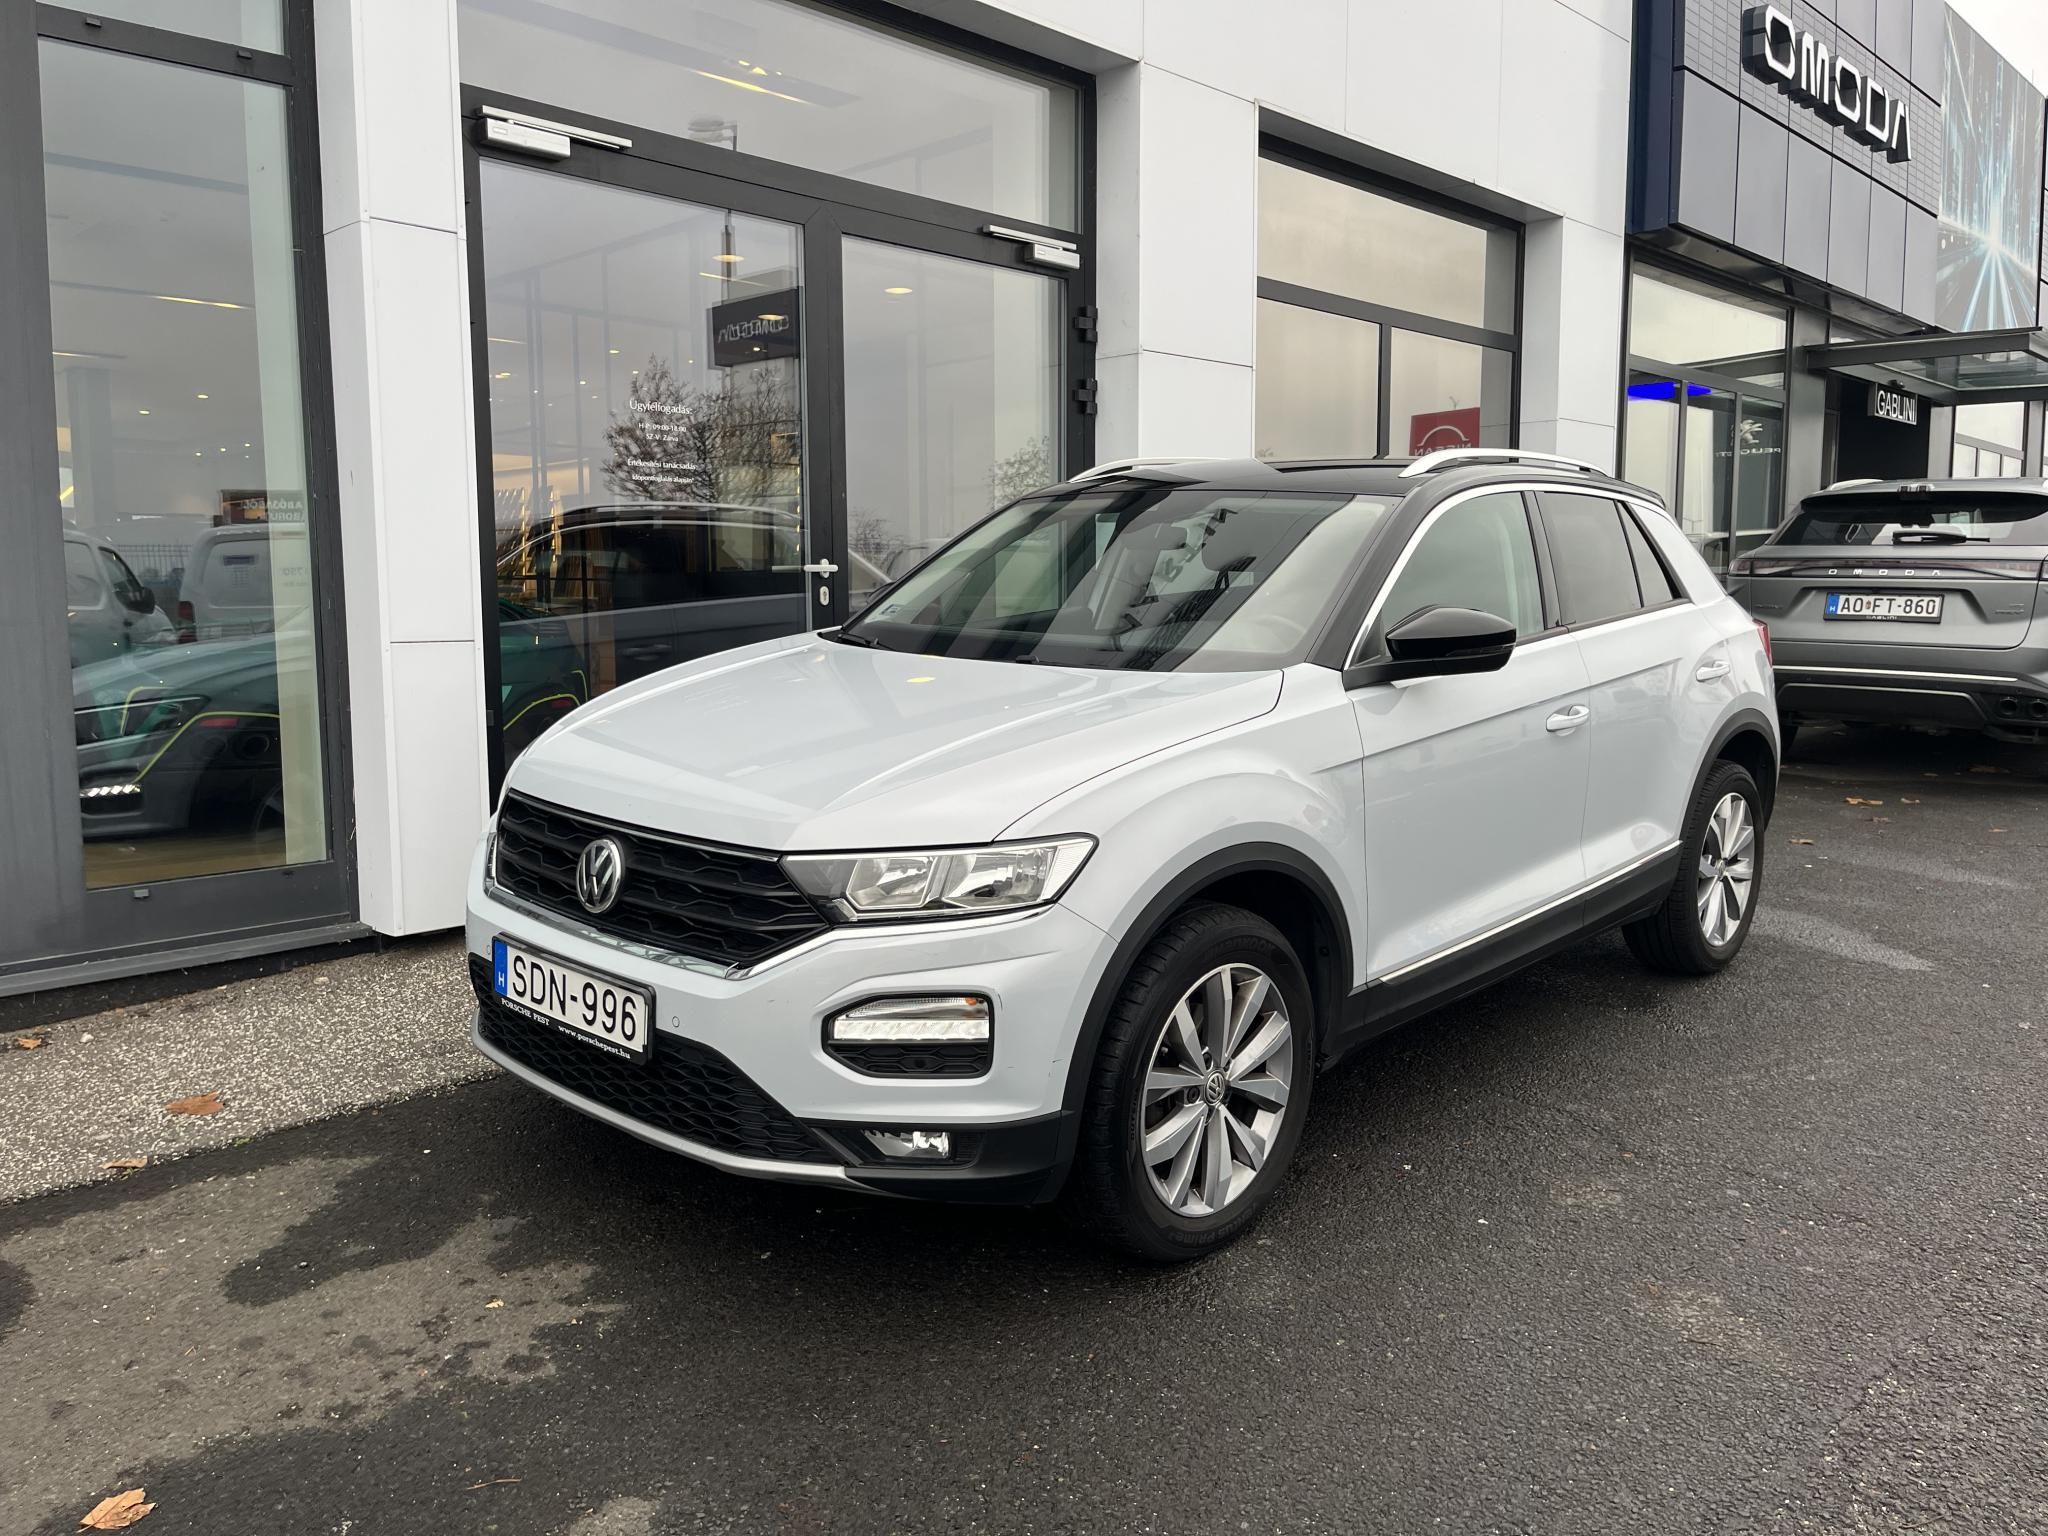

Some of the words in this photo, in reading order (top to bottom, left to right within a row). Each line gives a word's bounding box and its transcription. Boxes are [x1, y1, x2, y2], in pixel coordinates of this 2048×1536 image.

[1765, 5, 1912, 161] OMODA
[1877, 390, 1916, 423] GABLINI
[1828, 568, 1941, 577] OMODA
[498, 971, 505, 988] H
[512, 955, 637, 1042] SDN-996
[501, 997, 532, 1020] PORSCHE
[558, 1025, 631, 1060] www.porschepest.hu
